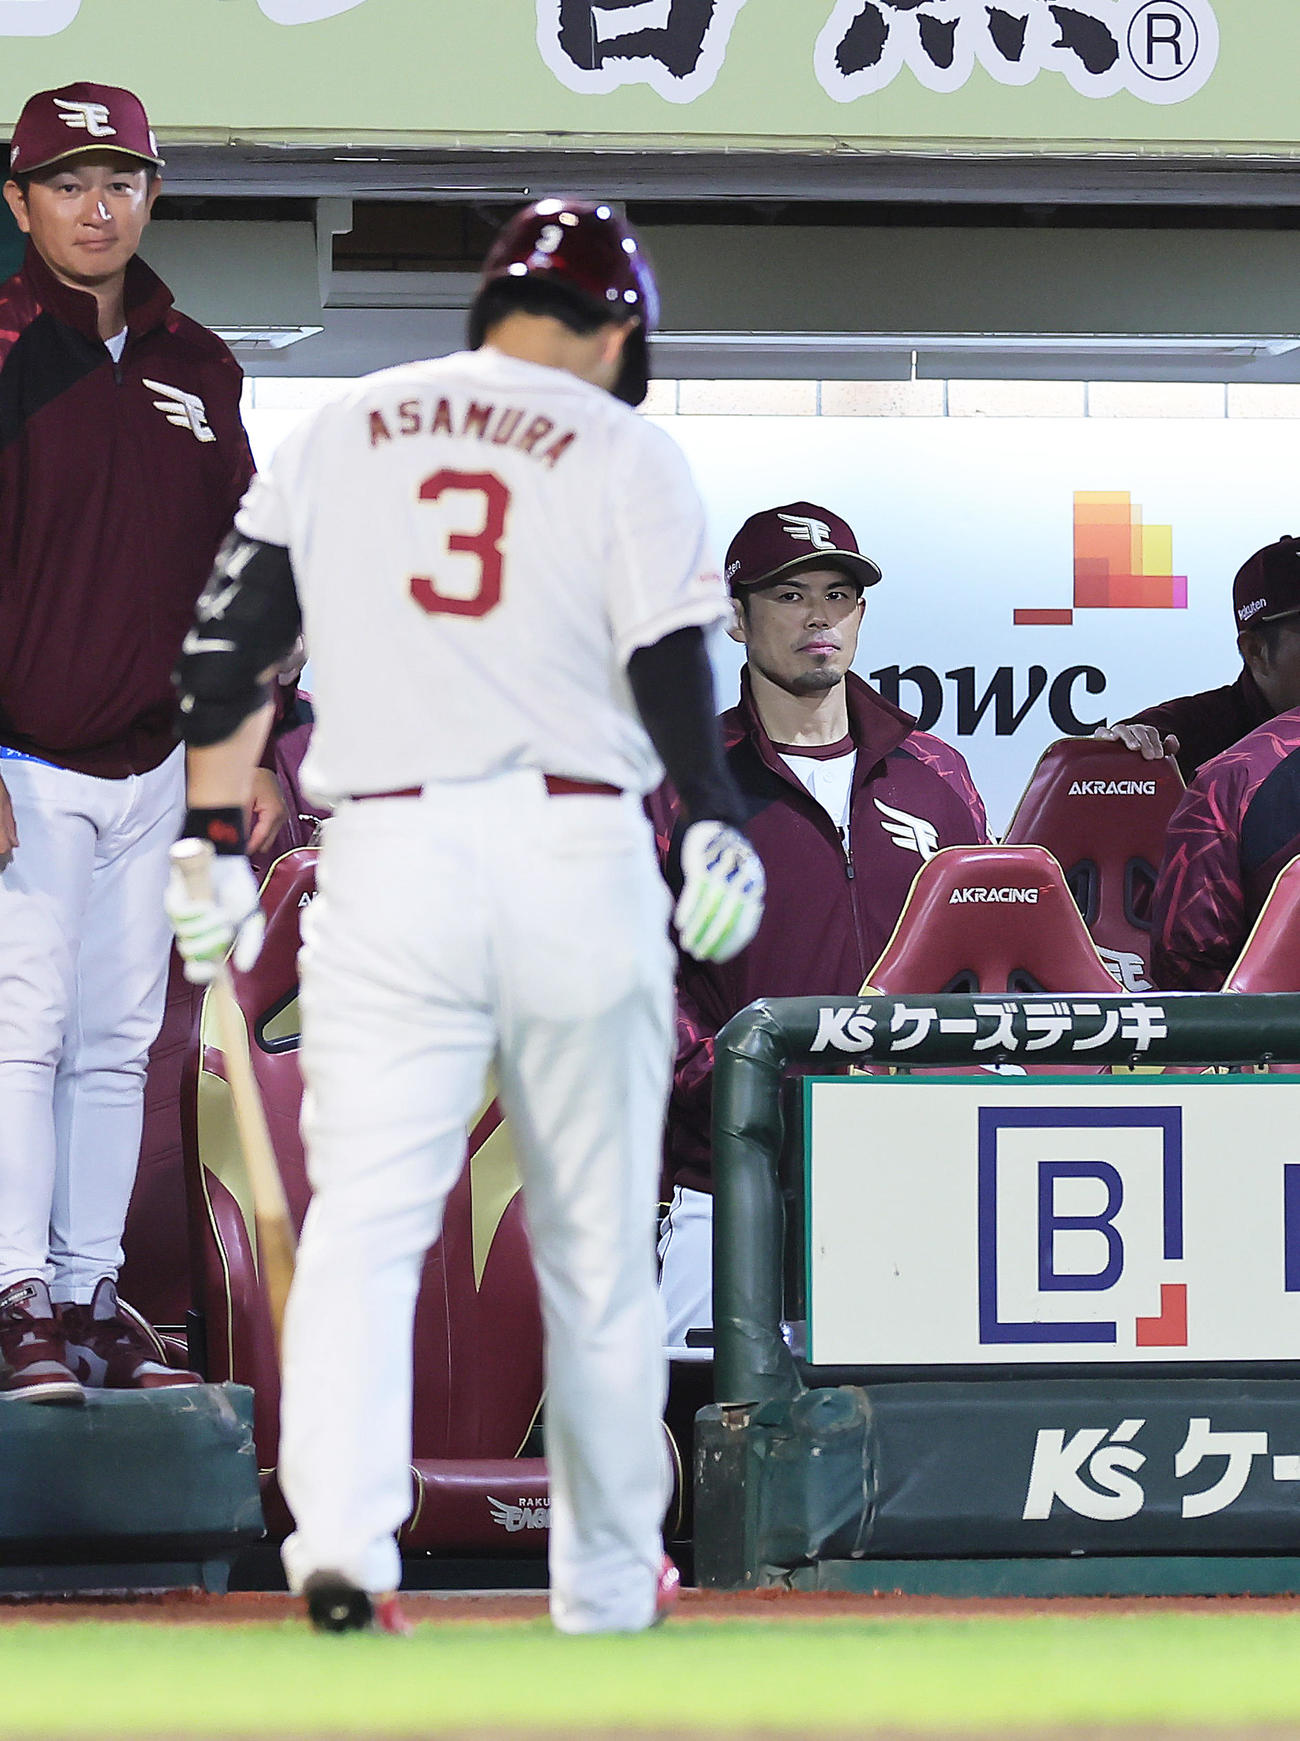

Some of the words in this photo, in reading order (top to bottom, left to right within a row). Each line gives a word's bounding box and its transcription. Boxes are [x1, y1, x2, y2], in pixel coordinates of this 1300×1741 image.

[369, 397, 577, 468] ASAMURA
[410, 467, 511, 618] 3
[869, 664, 1107, 736] pwc
[1068, 780, 1156, 796] AKRACING
[949, 887, 1038, 905] AKRACING
[810, 1003, 877, 1053] K's
[889, 1002, 1168, 1052] ケーズデンキ
[1037, 1161, 1124, 1292] B
[1022, 1418, 1147, 1522] K's
